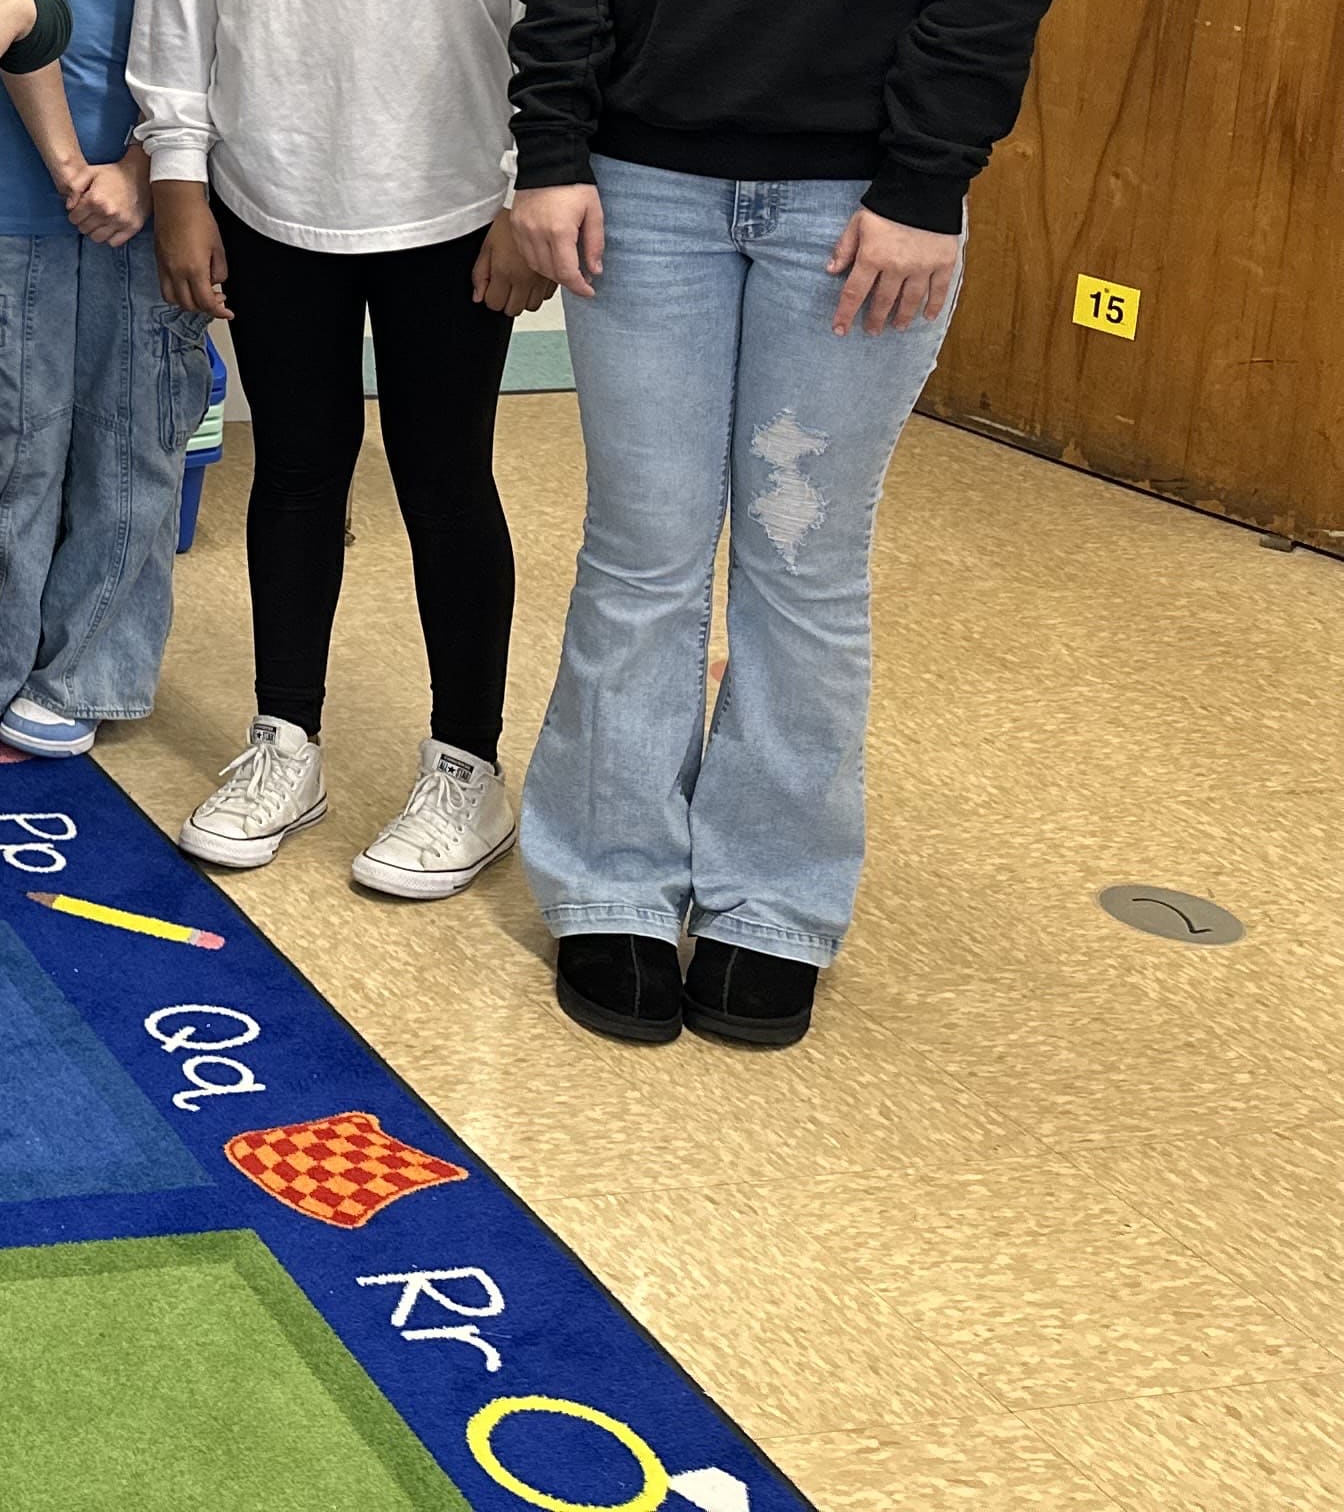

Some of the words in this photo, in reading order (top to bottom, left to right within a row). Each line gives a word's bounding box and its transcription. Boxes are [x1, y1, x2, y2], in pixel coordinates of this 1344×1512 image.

[1089, 291, 1125, 324] 15
[142, 1002, 266, 1112] Qq
[356, 1264, 505, 1375] Rr
